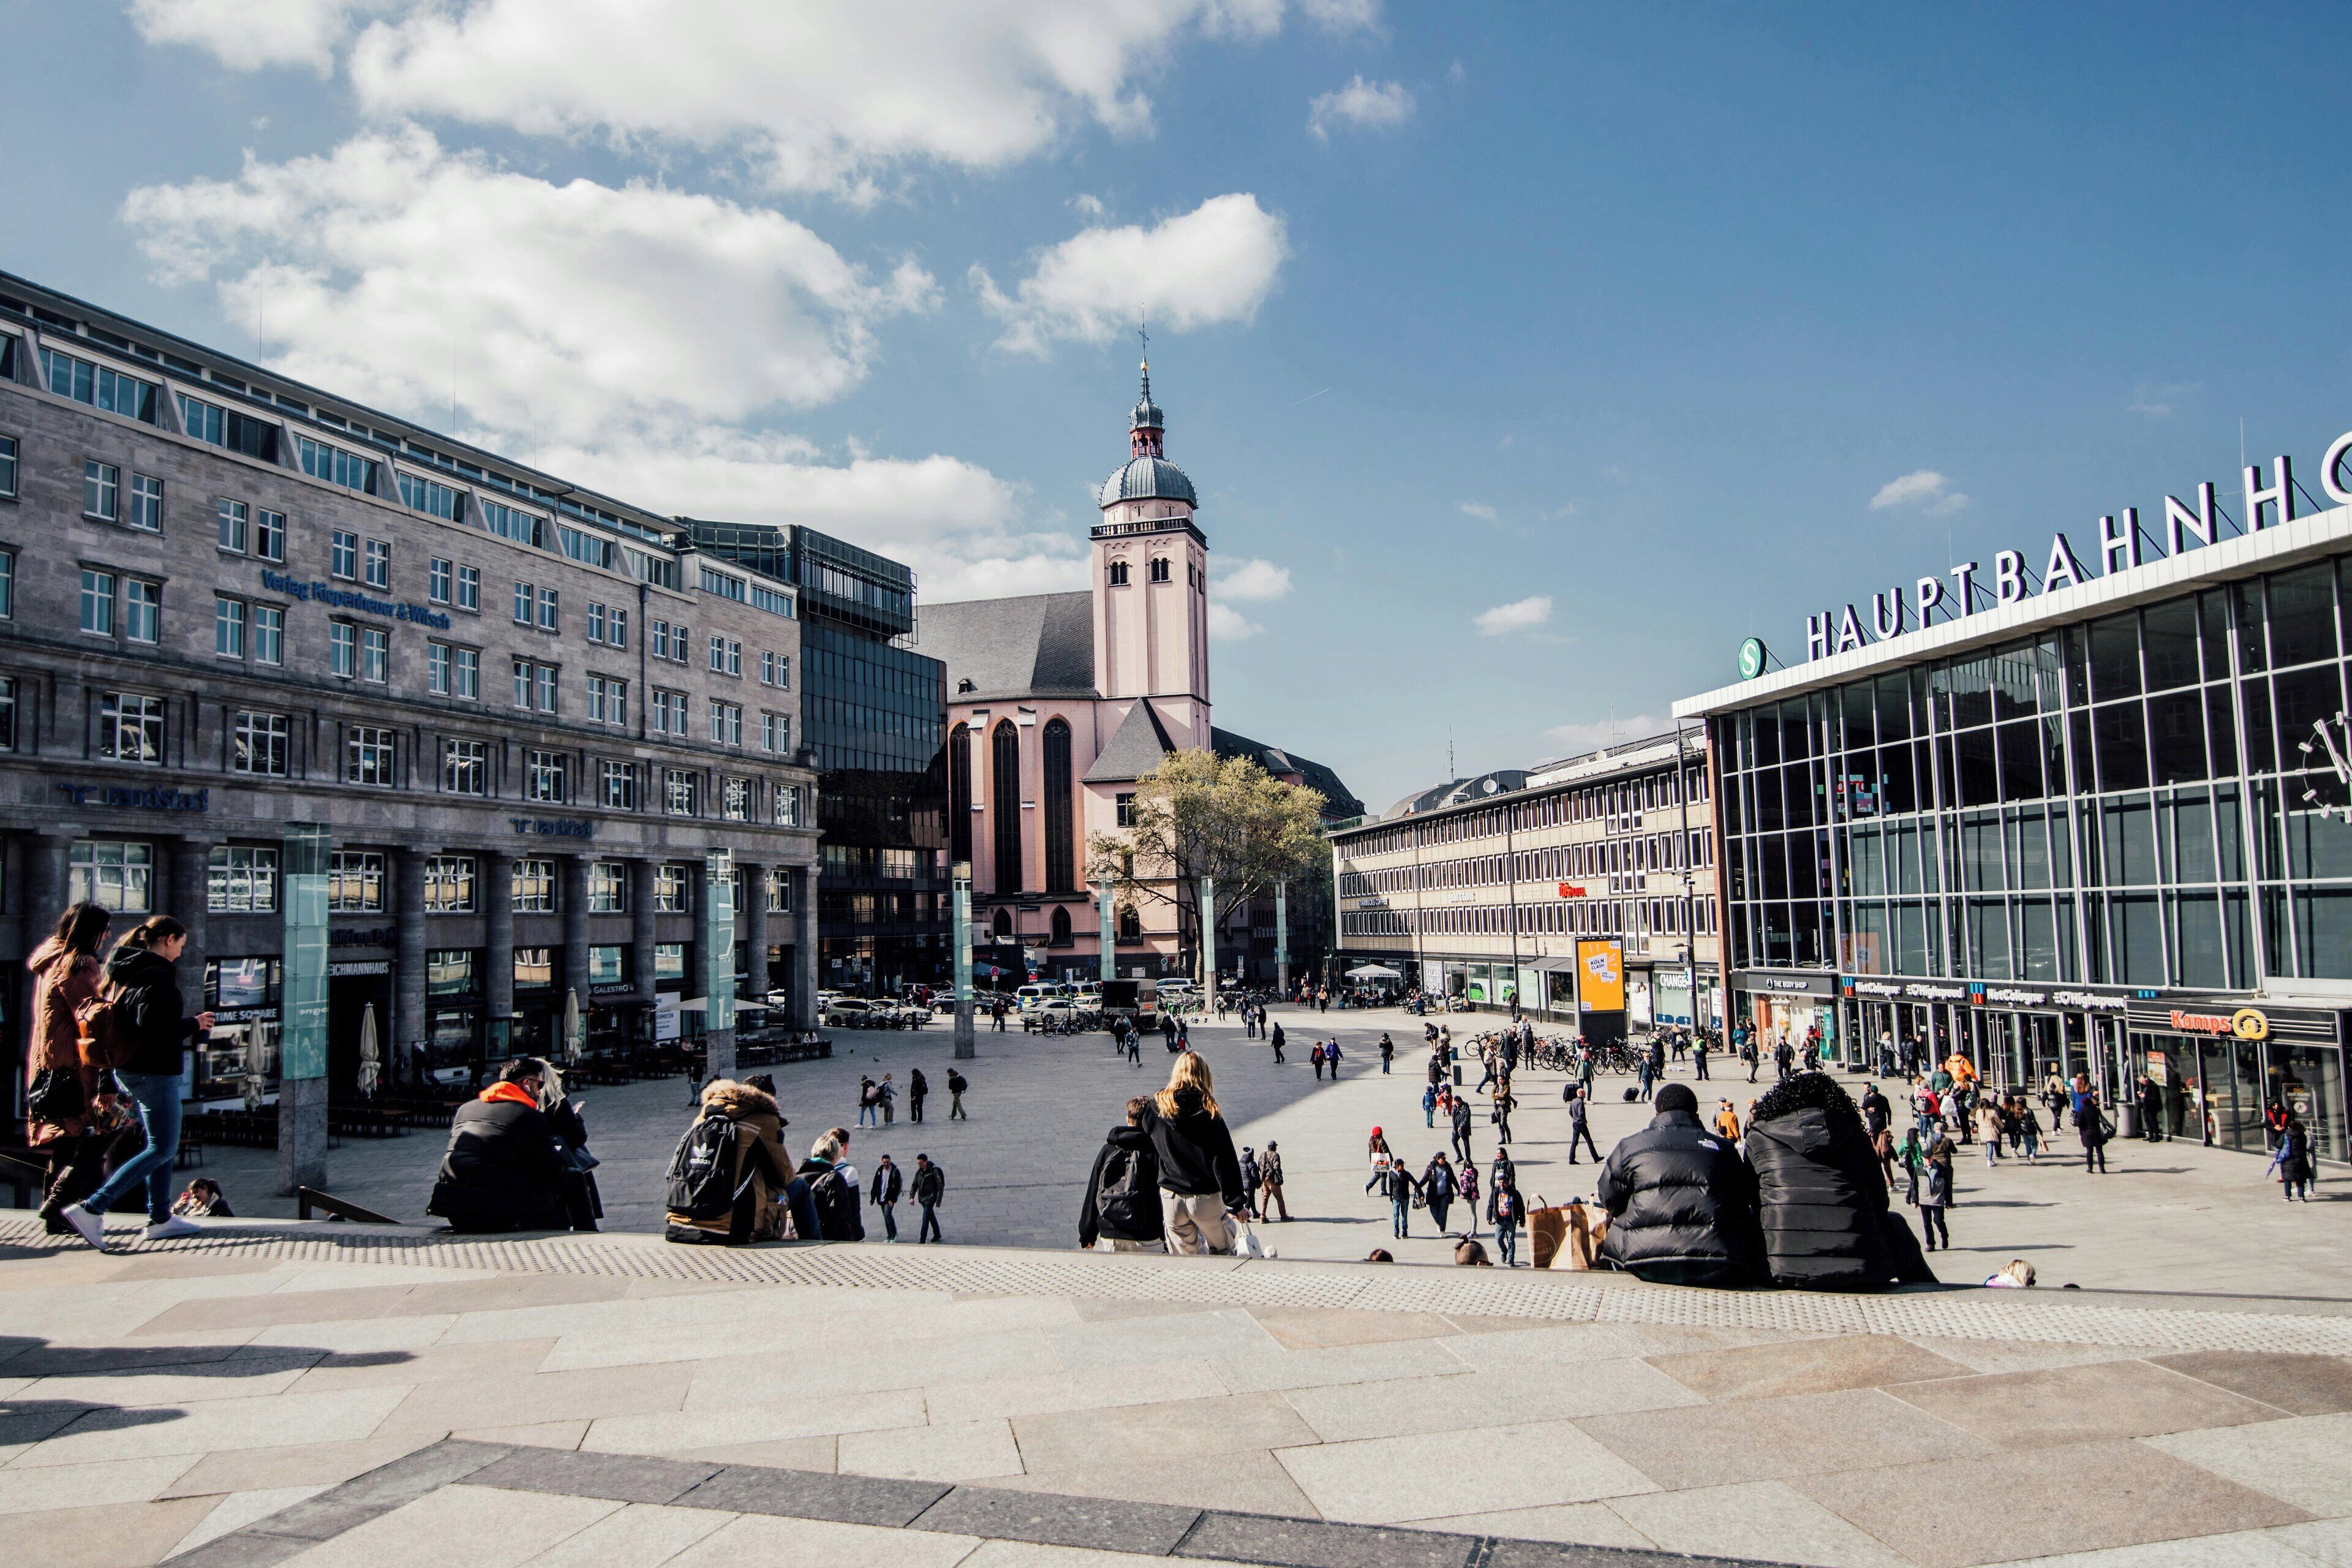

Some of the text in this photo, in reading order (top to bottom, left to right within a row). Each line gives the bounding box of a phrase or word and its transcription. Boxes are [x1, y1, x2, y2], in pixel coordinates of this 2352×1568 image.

[262, 569, 450, 630] Verlag Kiepenheuer & Witsch
[1742, 643, 1757, 676] S
[107, 785, 208, 812] randstad
[535, 818, 593, 837] randstad
[594, 984, 628, 993] GALESTRO
[1660, 974, 1686, 988] CHANGE
[1855, 981, 1966, 1000] NetCologne Highspeed
[1986, 988, 2046, 1005] NetCologne
[215, 1011, 238, 1021] TIME
[2170, 1010, 2233, 1035] Kamps
